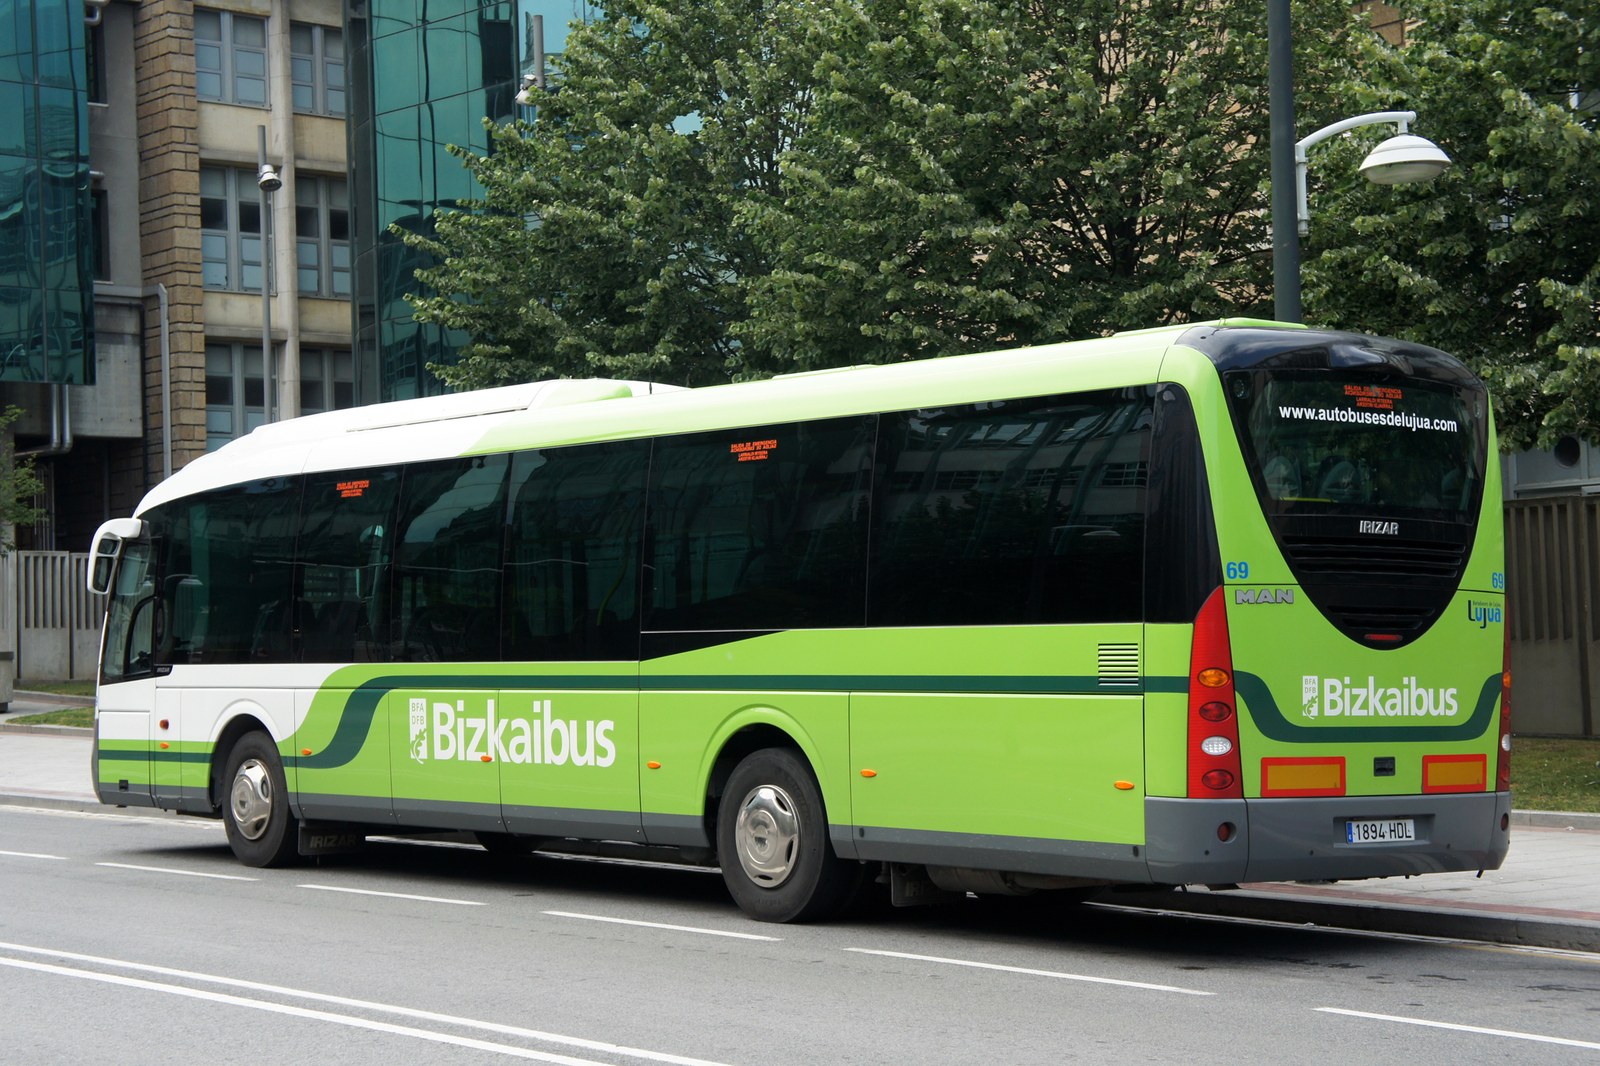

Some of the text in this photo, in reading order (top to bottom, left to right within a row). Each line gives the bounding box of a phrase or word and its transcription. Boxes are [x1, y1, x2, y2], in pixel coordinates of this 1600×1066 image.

[1279, 406, 1458, 433] www.autobusesdelujua.com
[1359, 520, 1399, 535] IRIZAR
[1226, 561, 1249, 579] 69
[1492, 572, 1504, 589] 69
[1235, 589, 1295, 604] MAN
[1468, 600, 1502, 629] Lujua
[1324, 676, 1458, 716] Bizkaibus
[411, 702, 424, 712] BFA
[411, 715, 425, 725] DFB
[433, 699, 616, 767] Bizkaibus
[1355, 822, 1412, 840] 1894 HDL
[309, 835, 356, 848] IRIZAR
